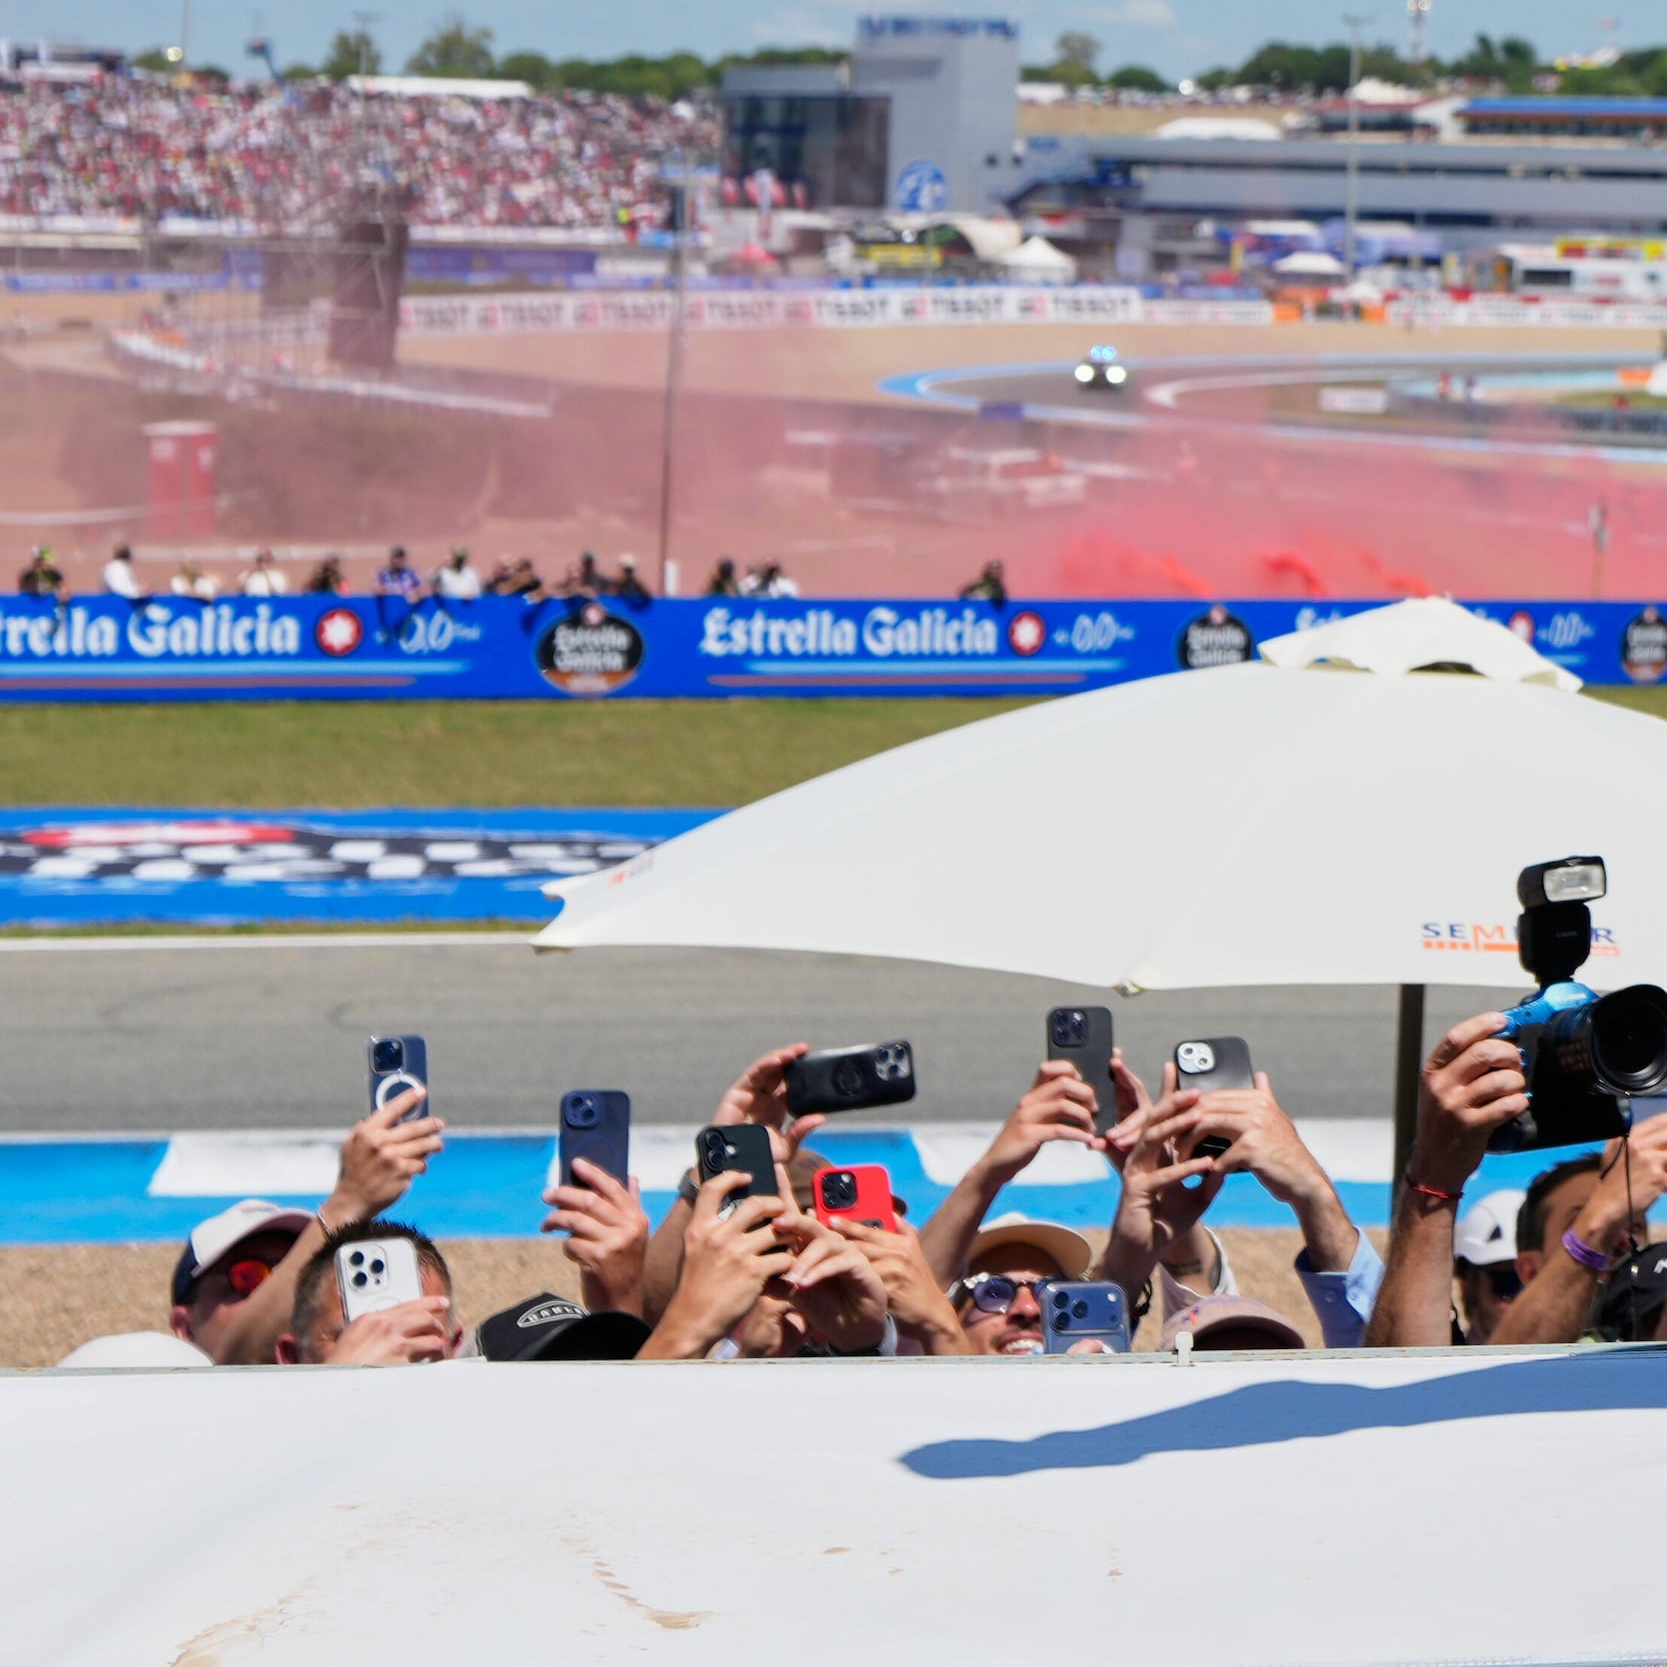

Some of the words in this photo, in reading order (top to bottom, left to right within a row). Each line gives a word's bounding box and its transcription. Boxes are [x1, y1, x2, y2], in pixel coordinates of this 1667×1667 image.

[126, 604, 302, 657] Galicia
[699, 606, 858, 657] Estrella
[862, 605, 998, 657] Galicia
